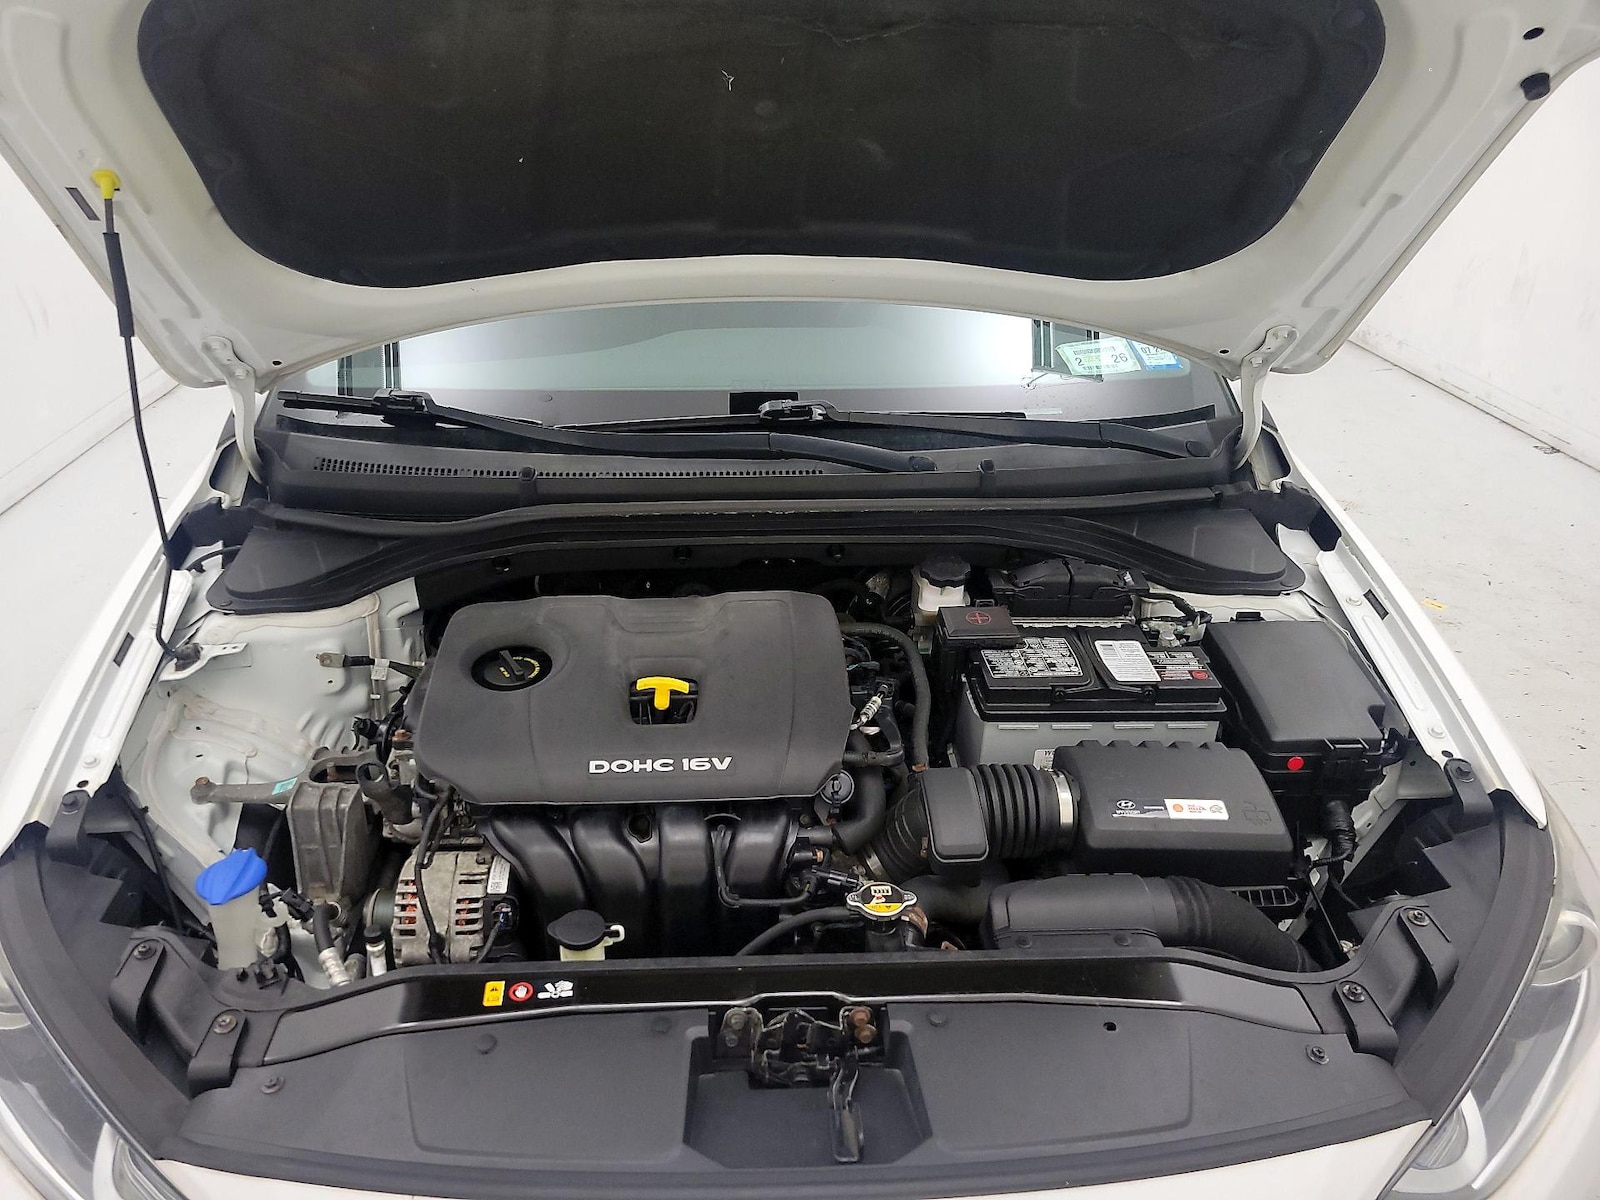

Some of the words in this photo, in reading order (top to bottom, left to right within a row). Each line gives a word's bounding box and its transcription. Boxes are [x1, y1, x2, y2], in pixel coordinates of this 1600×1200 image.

[1075, 357, 1085, 367] 2
[1111, 352, 1128, 364] 26
[588, 758, 675, 774] DOHC
[681, 756, 733, 771] 16V
